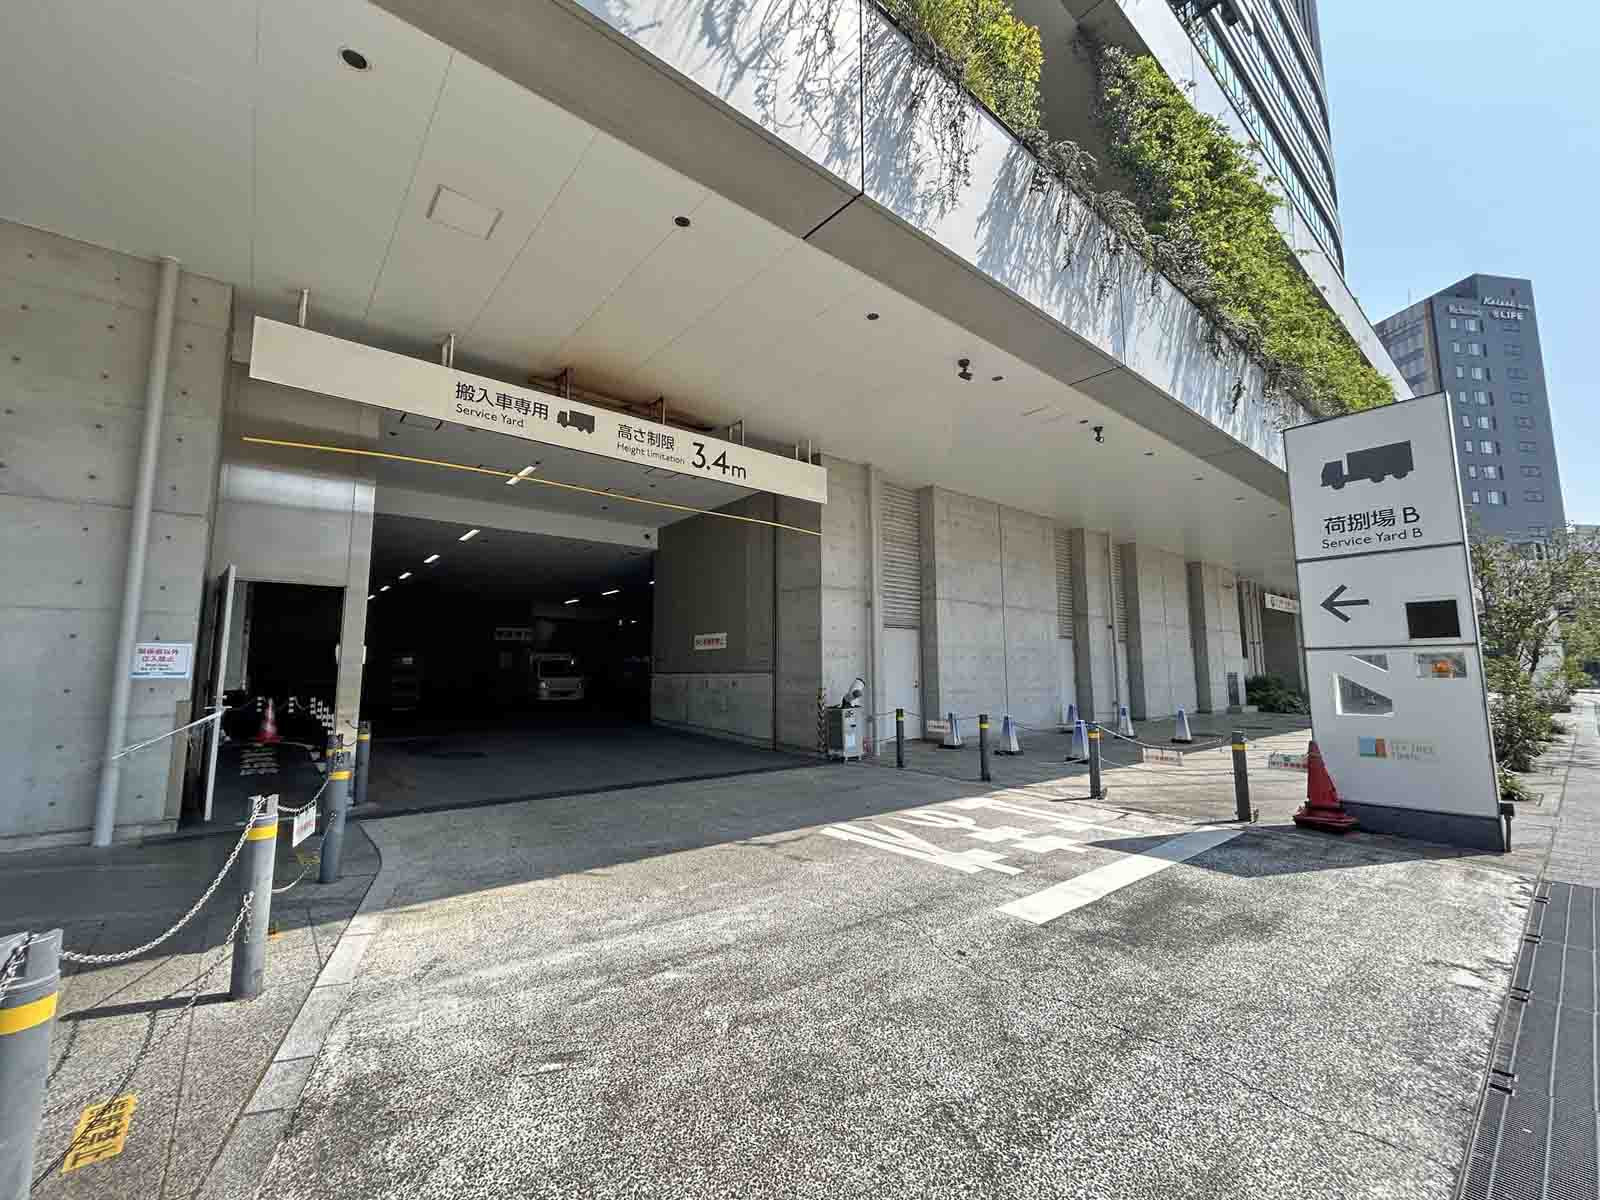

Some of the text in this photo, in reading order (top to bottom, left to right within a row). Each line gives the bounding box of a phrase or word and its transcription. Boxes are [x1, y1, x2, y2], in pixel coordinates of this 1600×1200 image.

[455, 381, 549, 421] 搬入車専用
[455, 403, 524, 428] Service Yard
[617, 423, 675, 451] 高さ制限
[616, 441, 686, 465] Height Limitation
[691, 441, 748, 481] 3.4m
[1323, 506, 1421, 534] 荷捌場 B
[1321, 527, 1423, 549] Service Yard B
